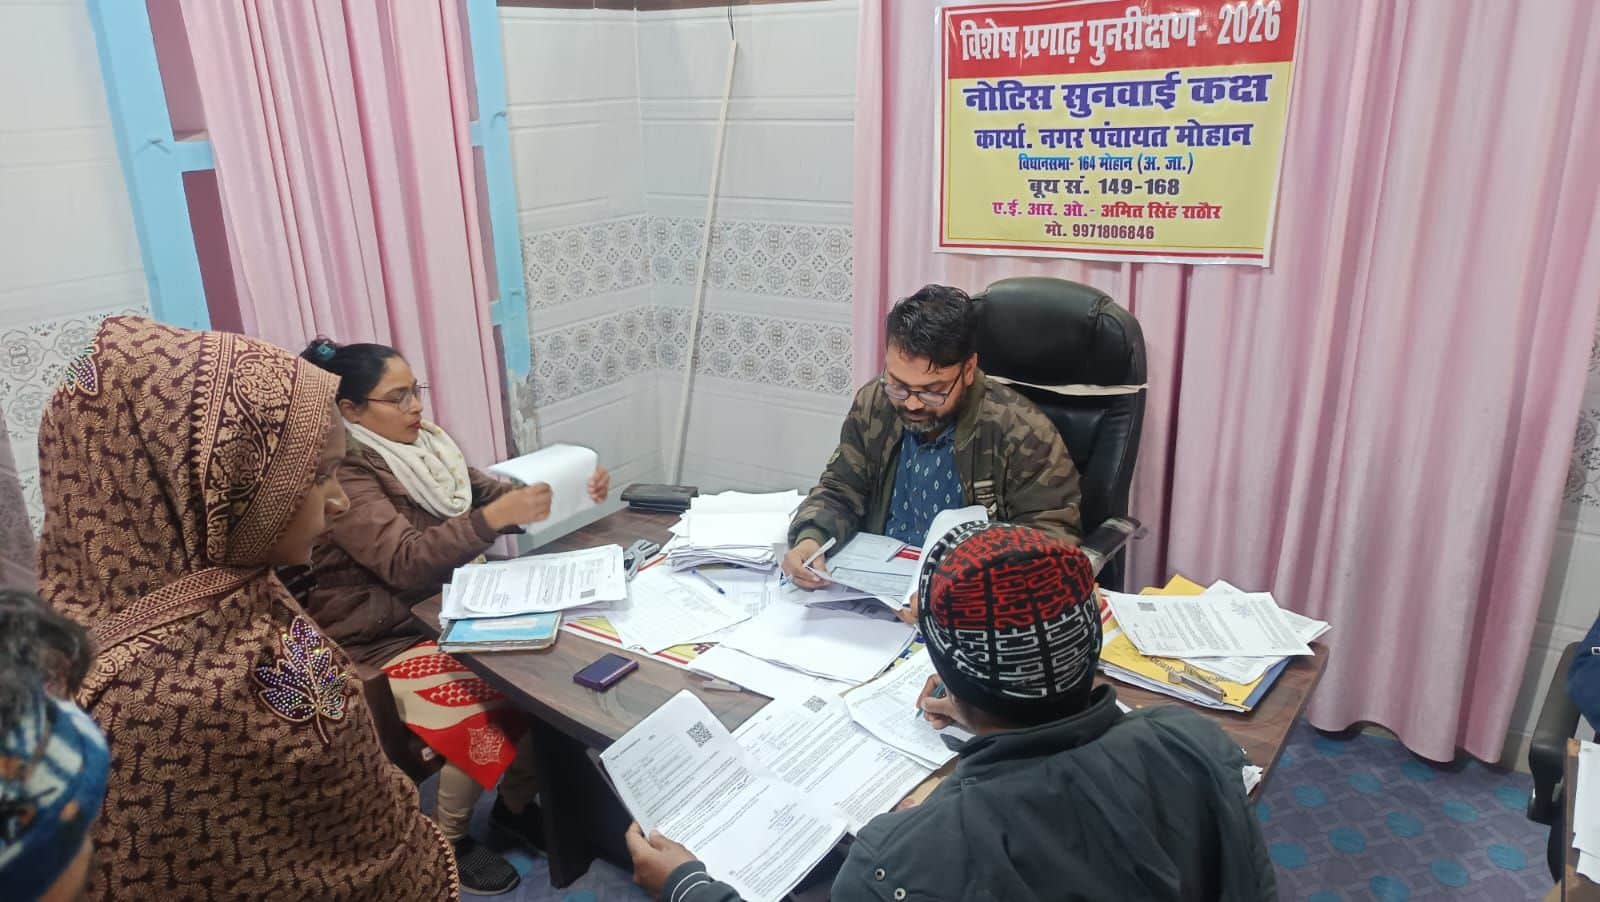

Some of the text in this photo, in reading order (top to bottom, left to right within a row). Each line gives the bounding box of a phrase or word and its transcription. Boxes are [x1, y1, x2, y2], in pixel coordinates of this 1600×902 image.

[959, 17, 1019, 61] विशेष
[1022, 19, 1083, 64] प्रगाढ़
[1217, 0, 1282, 45] 2026
[962, 71, 1273, 118] नोटिस सुनवाई कक्ष
[975, 118, 1254, 149] कार्या. नगर पंचायत मोहान
[1078, 155, 1096, 171] 164
[1098, 153, 1133, 171] मोहान
[1064, 175, 1089, 194] सं.
[1098, 178, 1180, 196] 149-168
[1027, 202, 1057, 216] आर.
[1101, 201, 1144, 219] अमित
[1147, 201, 1178, 219] सिंह
[1181, 202, 1223, 219] राठौर
[1044, 221, 1155, 240] मो. 9971806846
